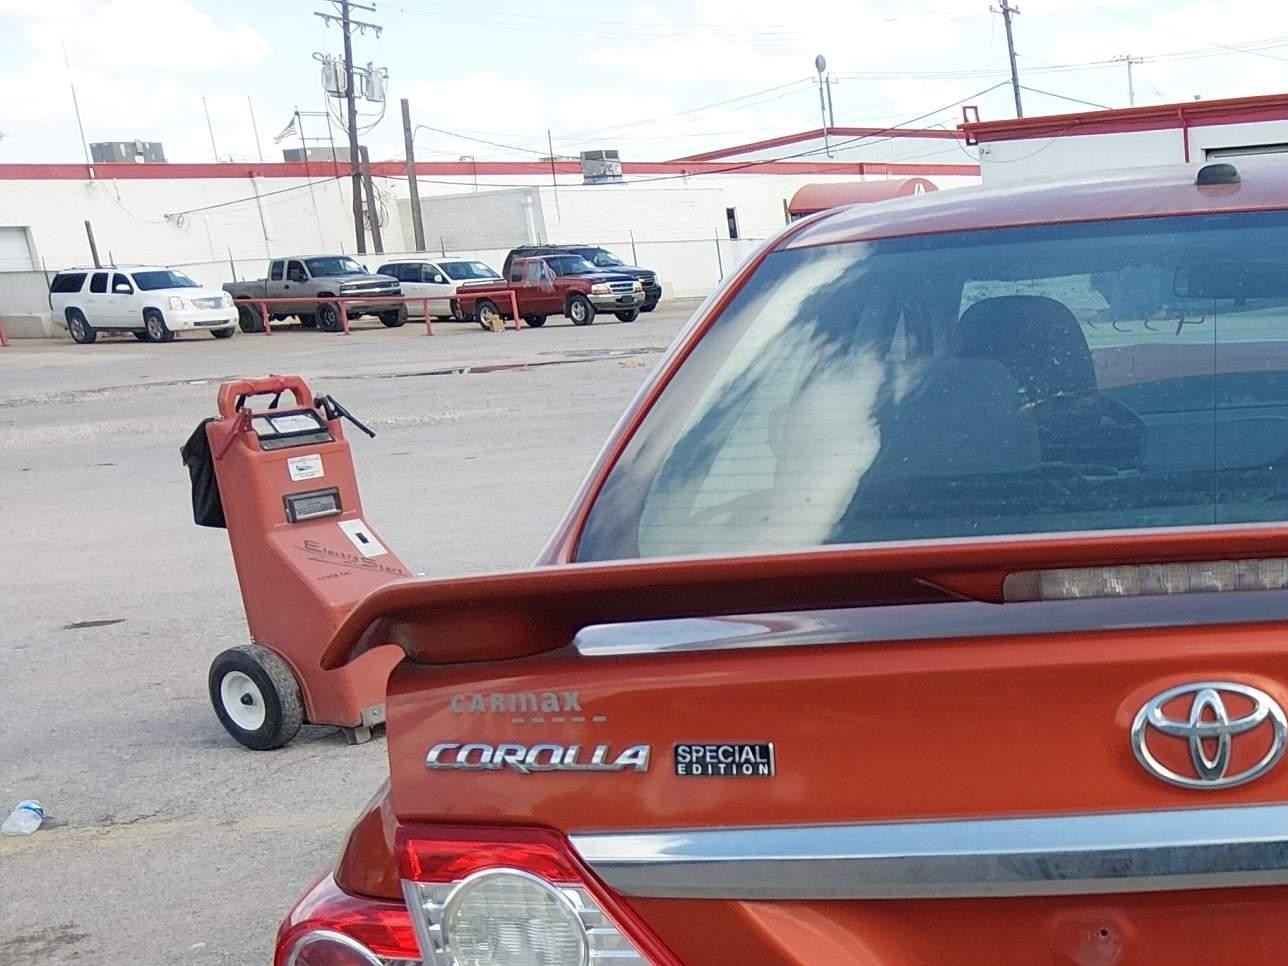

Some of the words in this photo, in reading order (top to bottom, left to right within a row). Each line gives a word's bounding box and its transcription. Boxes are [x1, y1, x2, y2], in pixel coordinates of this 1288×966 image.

[425, 742, 651, 774] COROLLA
[677, 746, 767, 763] SPECIAL
[677, 763, 769, 776] EDITION
